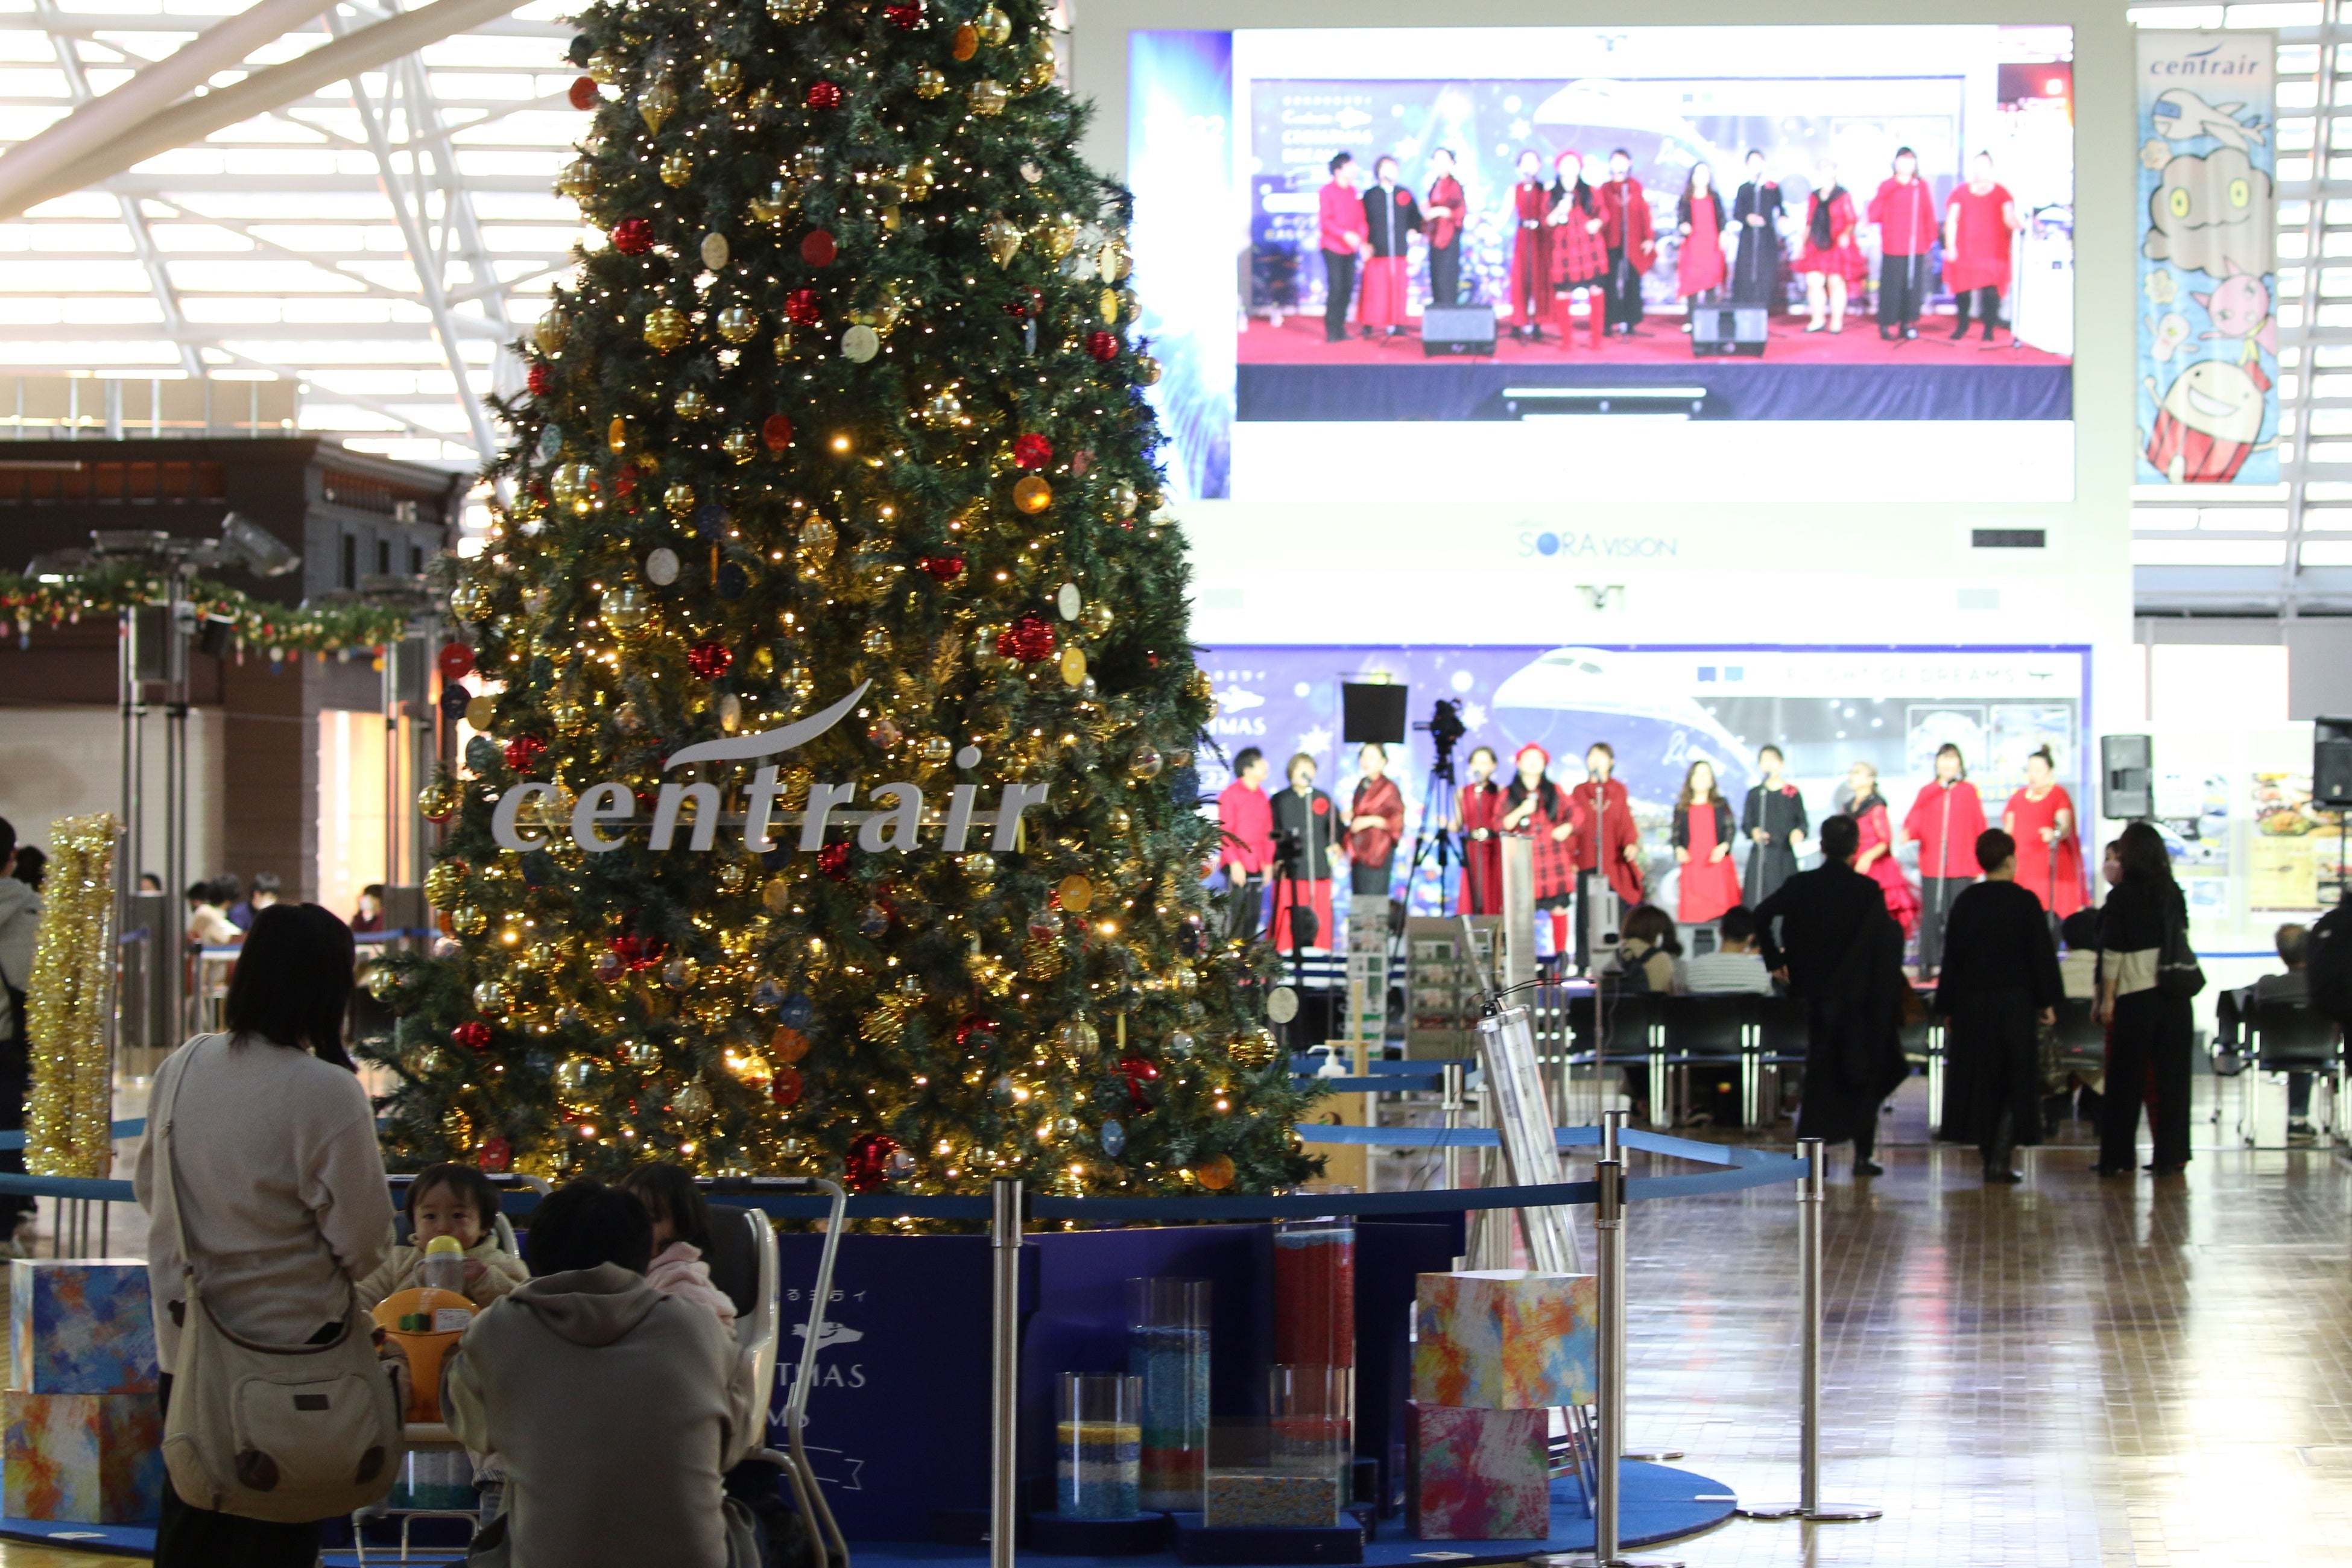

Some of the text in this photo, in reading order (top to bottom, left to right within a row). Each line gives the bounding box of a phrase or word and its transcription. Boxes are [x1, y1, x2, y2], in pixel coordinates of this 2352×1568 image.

[2150, 55, 2259, 74] centrair
[1602, 537, 1677, 557] VISION
[491, 745, 1050, 853] centrair
